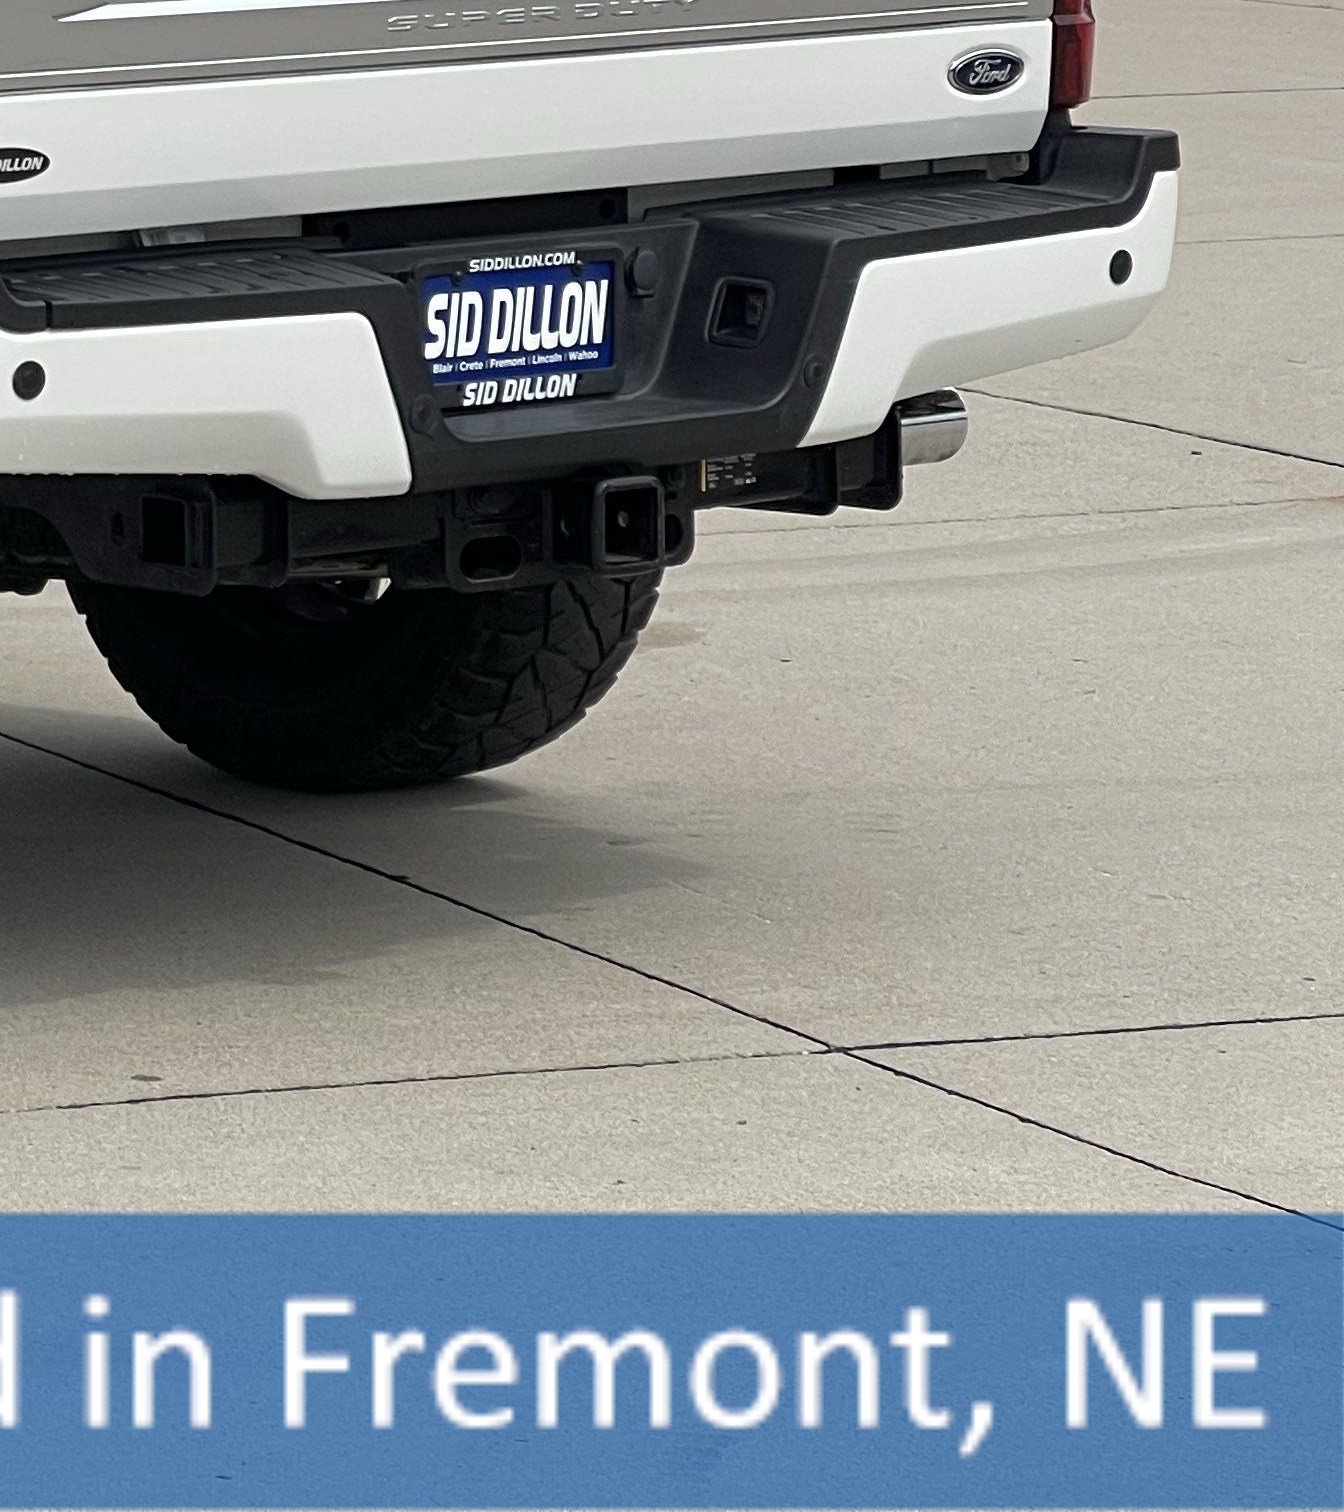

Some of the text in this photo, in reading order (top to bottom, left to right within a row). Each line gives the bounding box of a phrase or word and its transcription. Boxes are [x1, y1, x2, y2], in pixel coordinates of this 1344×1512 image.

[387, 4, 561, 31] SUPER
[969, 58, 1012, 85] Ford
[469, 251, 576, 273] SIDDILLON.COM
[424, 279, 609, 360] SID DILLON
[432, 349, 599, 375] Blair Crete Fremont Lincoln Wahoo
[463, 373, 577, 407] SID DILLON
